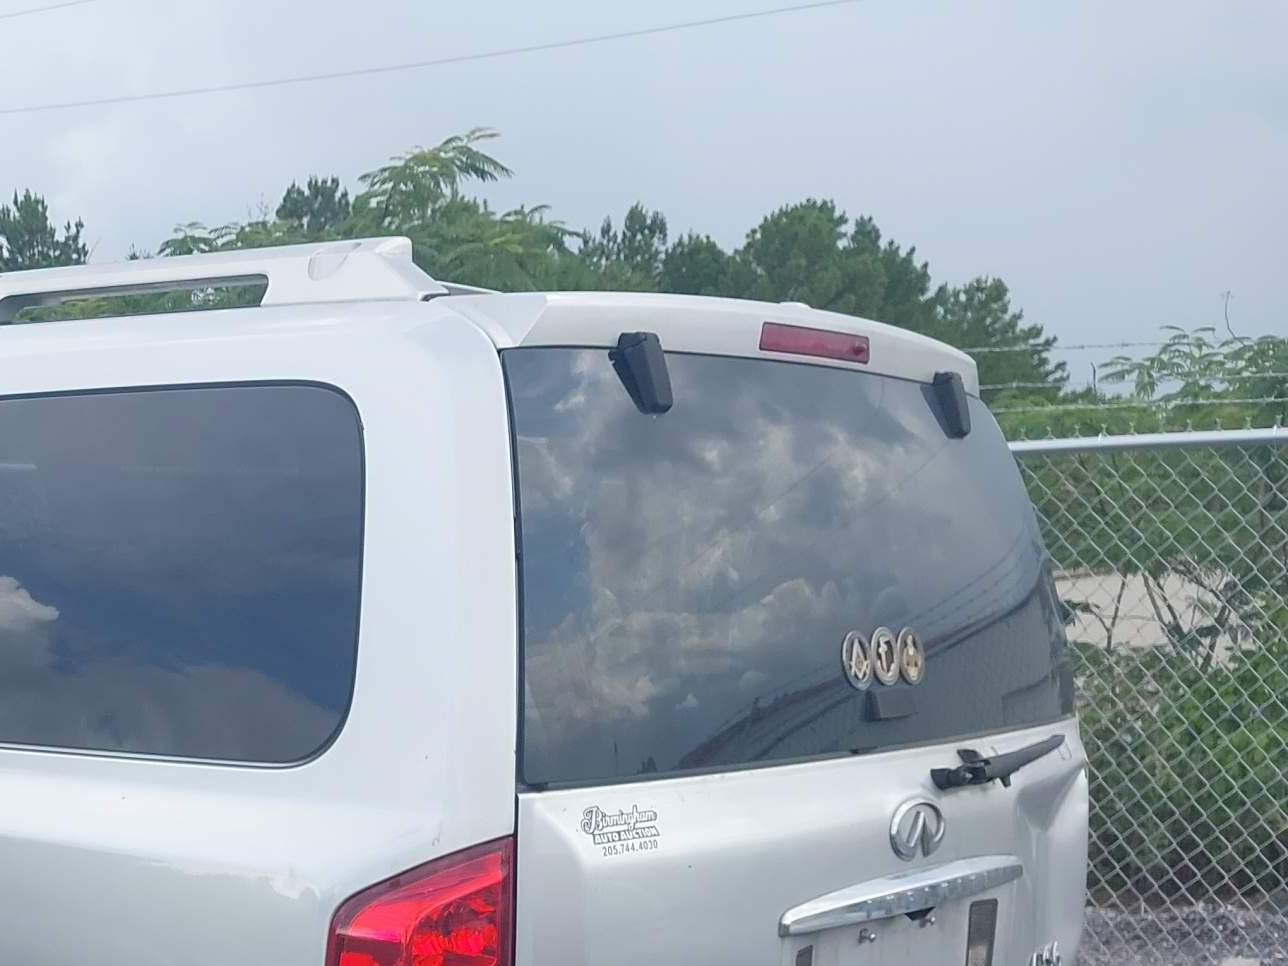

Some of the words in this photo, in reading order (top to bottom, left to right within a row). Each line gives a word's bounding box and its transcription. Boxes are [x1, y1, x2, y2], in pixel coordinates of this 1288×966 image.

[581, 804, 658, 834] Birmingham
[593, 831, 620, 844] AUTO
[619, 826, 659, 841] AUCTION
